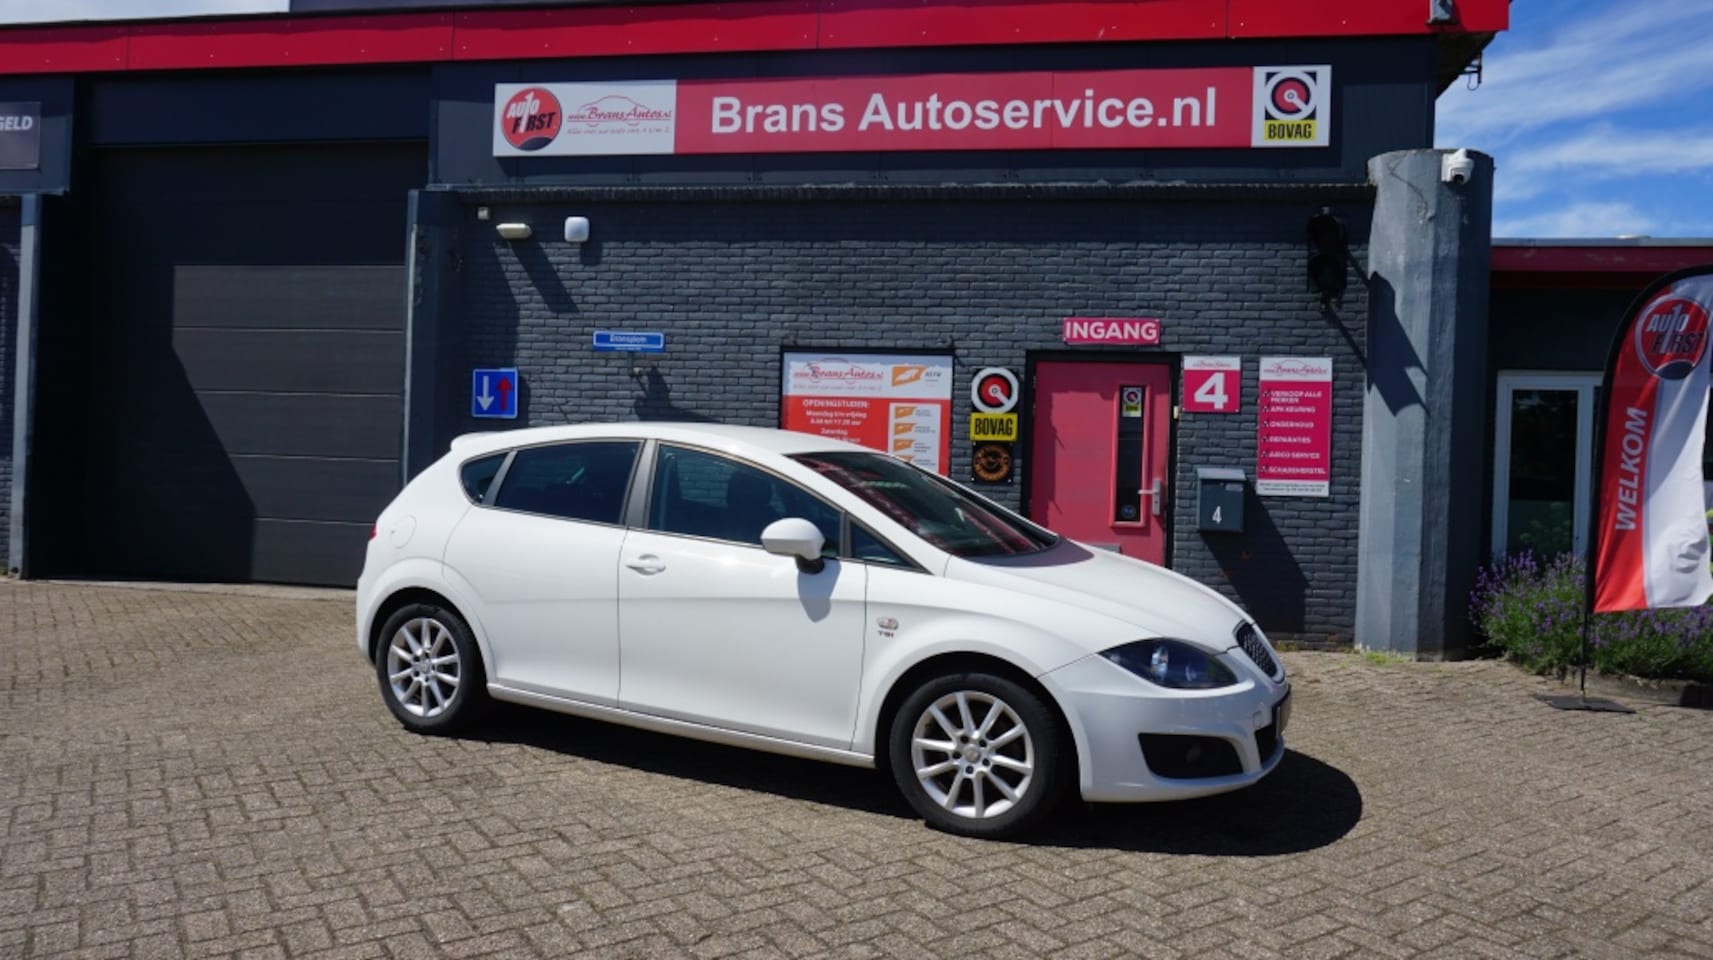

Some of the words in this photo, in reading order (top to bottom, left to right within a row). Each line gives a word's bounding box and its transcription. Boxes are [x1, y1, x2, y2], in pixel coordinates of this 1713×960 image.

[711, 97, 845, 133] Brans
[857, 86, 1216, 131] Autoservice.nl
[1268, 124, 1312, 140] BOVAG
[1065, 322, 1157, 340] INGANG
[1193, 372, 1229, 409] 4
[974, 418, 1014, 436] BOVAG
[1615, 407, 1648, 531] WELKOM
[1212, 505, 1223, 523] 4
